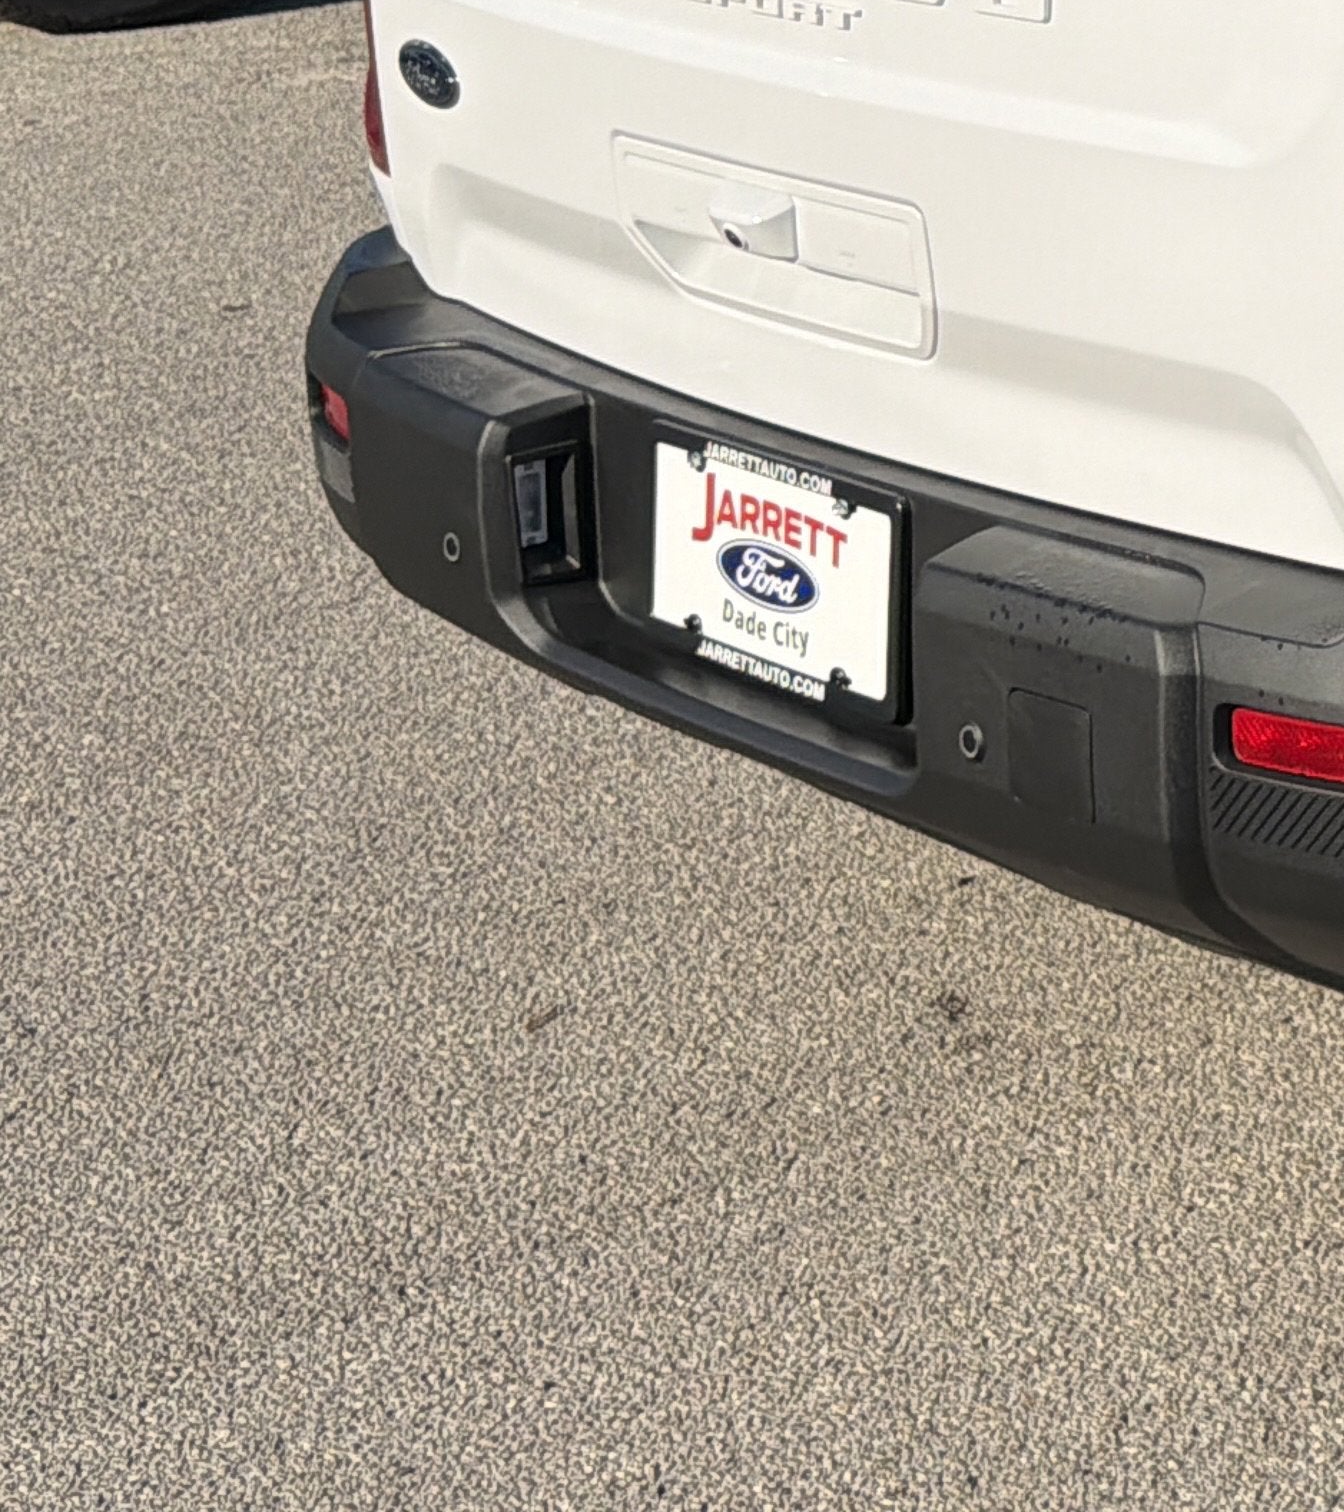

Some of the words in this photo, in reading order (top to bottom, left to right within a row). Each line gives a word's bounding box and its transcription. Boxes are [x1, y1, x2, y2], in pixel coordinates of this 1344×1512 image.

[703, 441, 832, 496] JARRETTAUTO.COM
[692, 472, 848, 568] JARRETT
[735, 547, 799, 603] Ford
[723, 599, 767, 640] Dade
[773, 622, 809, 657] City
[696, 639, 826, 701] JARRETTAUTO.COM
